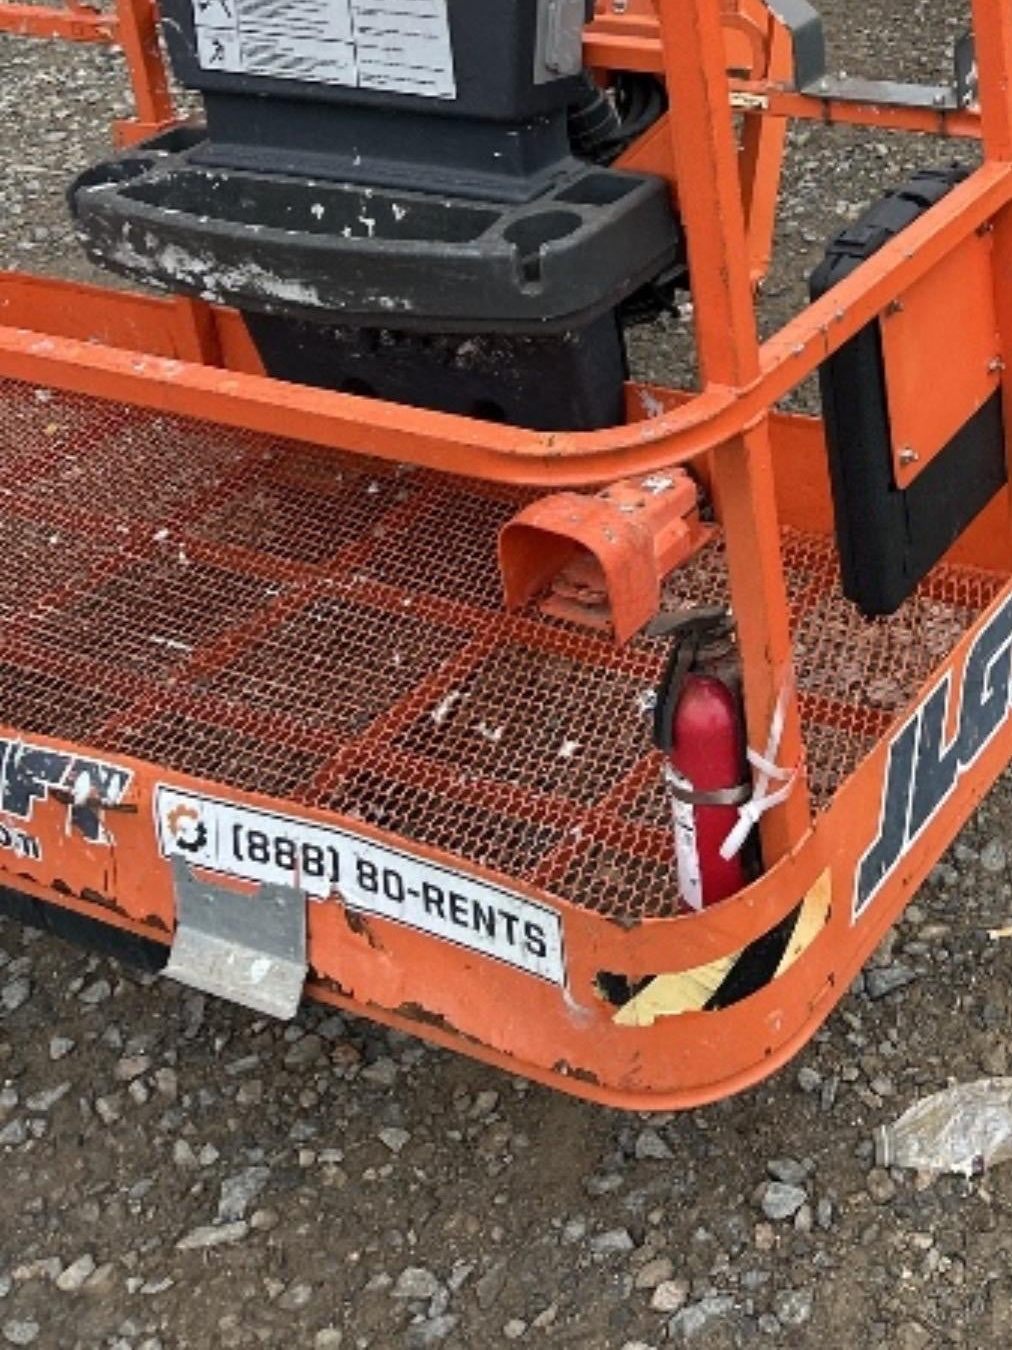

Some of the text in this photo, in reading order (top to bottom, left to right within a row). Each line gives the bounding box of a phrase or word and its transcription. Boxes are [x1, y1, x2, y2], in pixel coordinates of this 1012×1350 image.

[0, 738, 134, 847] FT
[231, 823, 548, 959] (888) 80-RENTS
